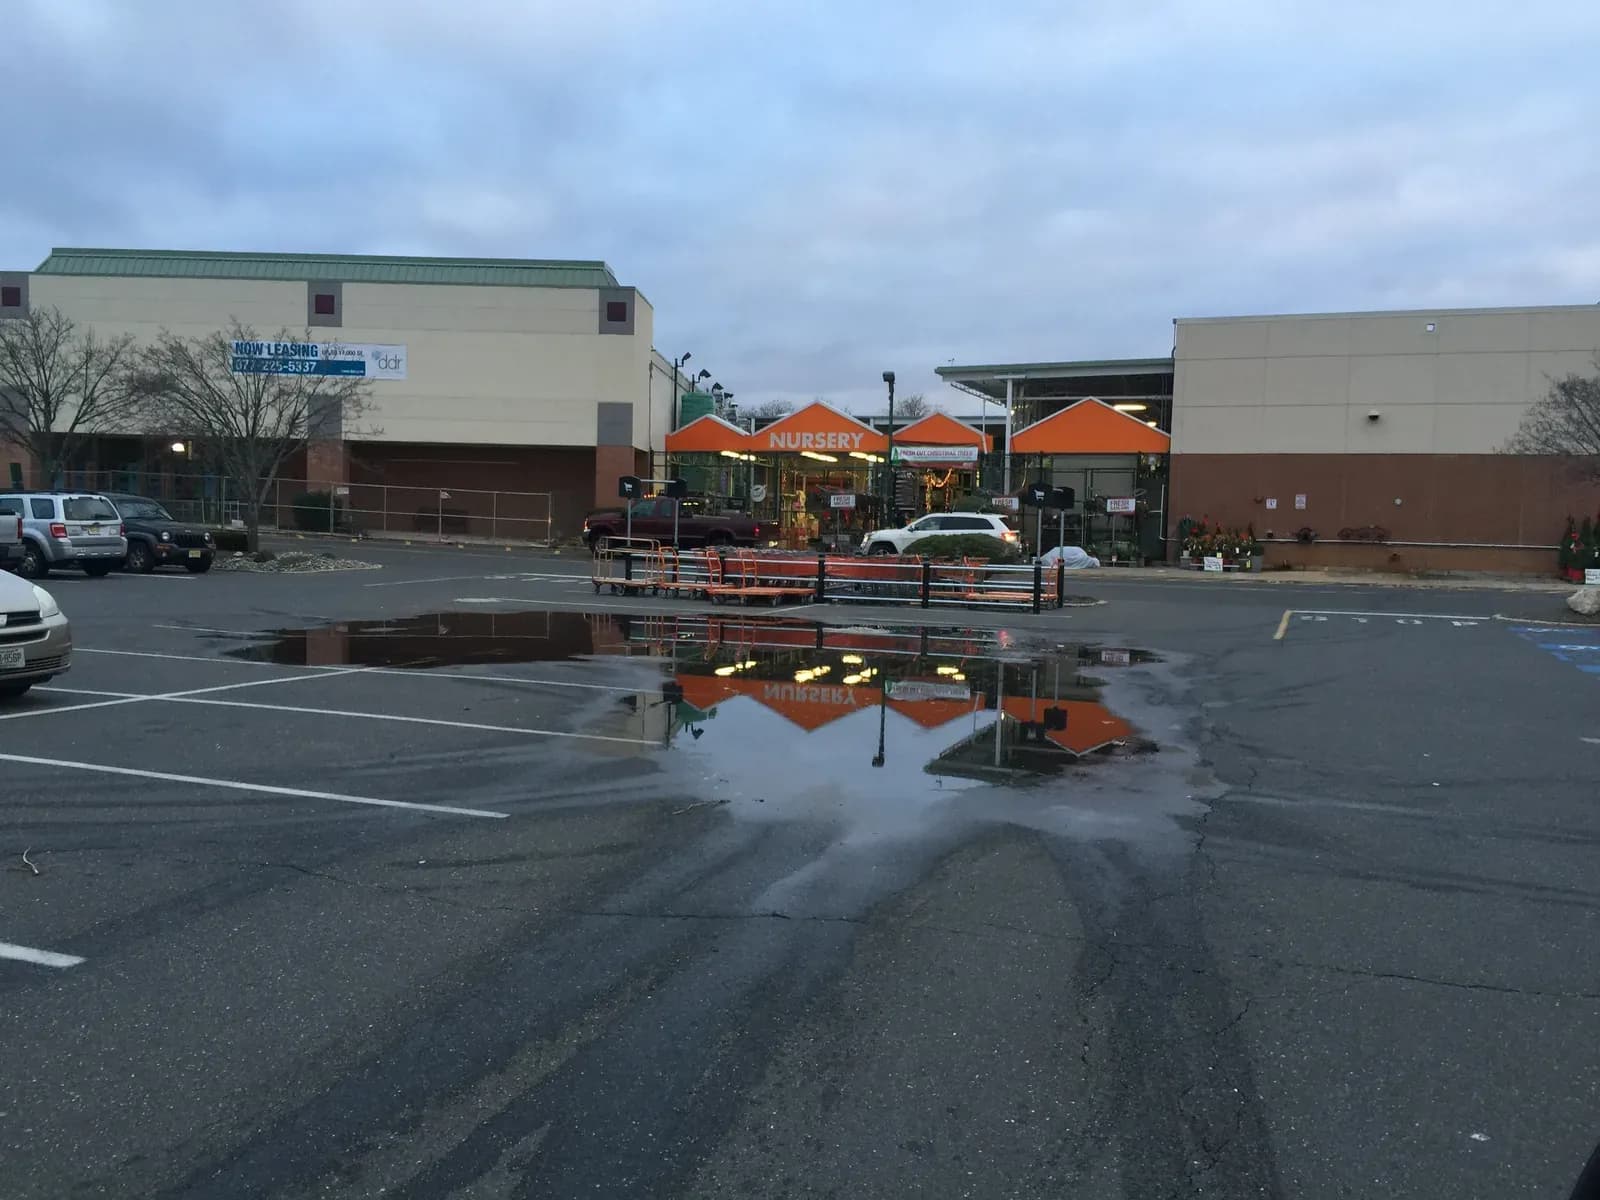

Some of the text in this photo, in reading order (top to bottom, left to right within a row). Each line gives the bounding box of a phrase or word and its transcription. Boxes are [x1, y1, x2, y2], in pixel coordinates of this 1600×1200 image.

[235, 342, 318, 358] NOW LEASING
[378, 354, 402, 369] ddr
[769, 432, 864, 449] NURSERY
